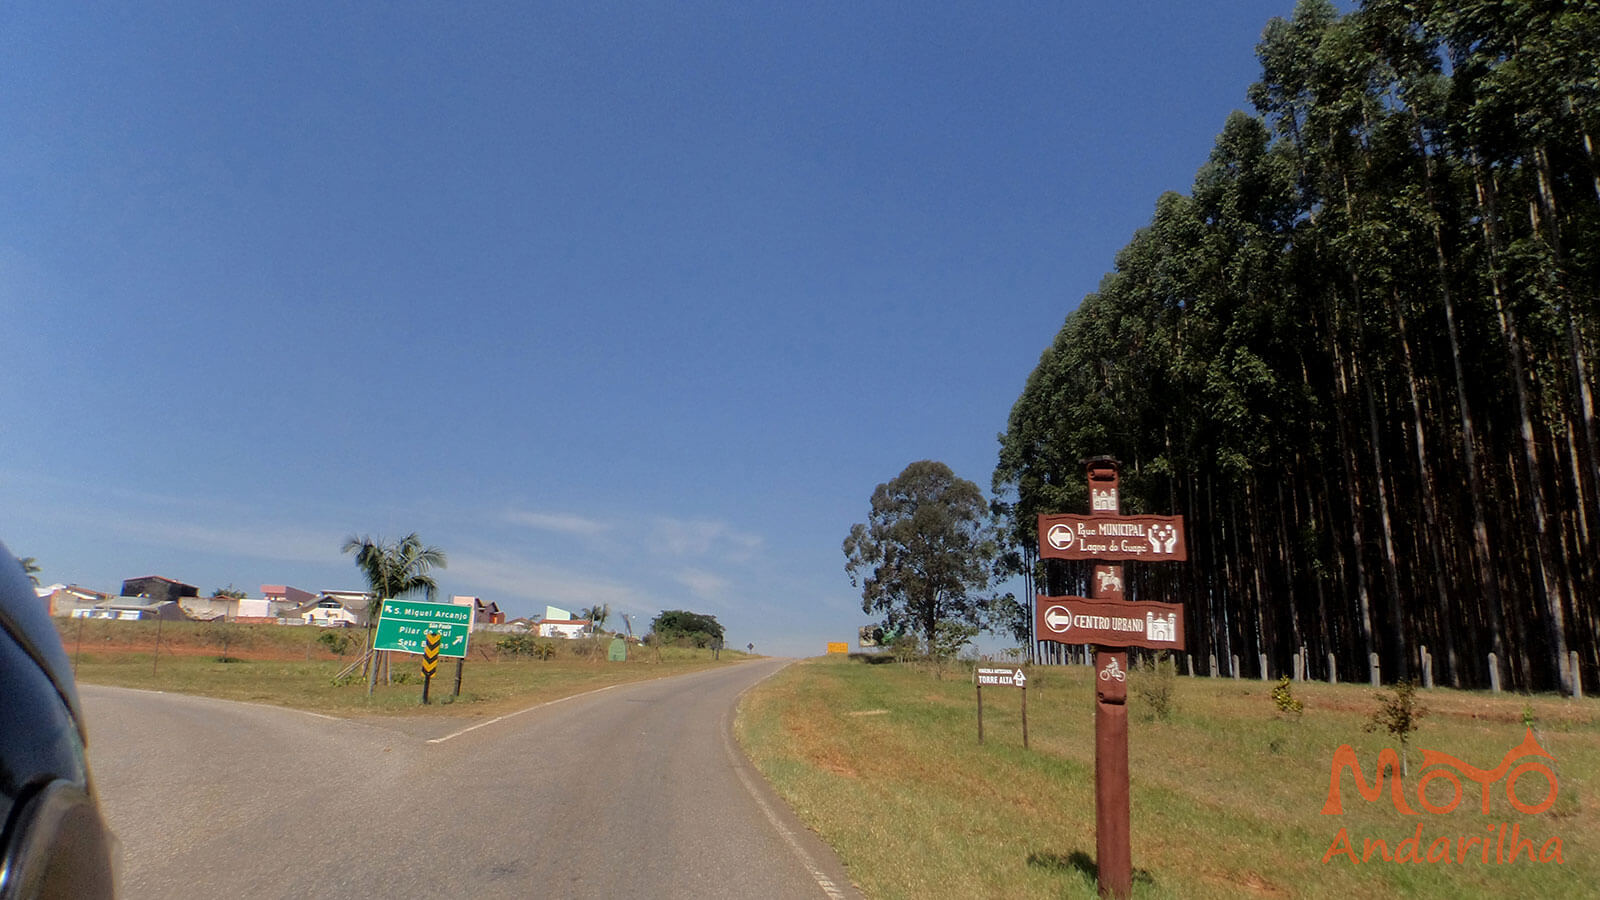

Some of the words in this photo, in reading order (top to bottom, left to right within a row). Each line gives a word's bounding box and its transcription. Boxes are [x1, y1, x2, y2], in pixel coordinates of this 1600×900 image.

[1099, 523, 1146, 537] MUNICIPAL
[1080, 538, 1107, 554] Lagoa
[394, 607, 401, 615] S.
[404, 608, 433, 618] Miguel
[435, 610, 468, 621] Arcanjo
[1073, 614, 1110, 630] CENTRO
[1111, 616, 1144, 633] URBANO
[399, 625, 421, 635] Pilar
[438, 629, 452, 637] Sul
[398, 638, 417, 647] Sete
[978, 675, 999, 684] TORRE
[999, 676, 1014, 685] ALTA
